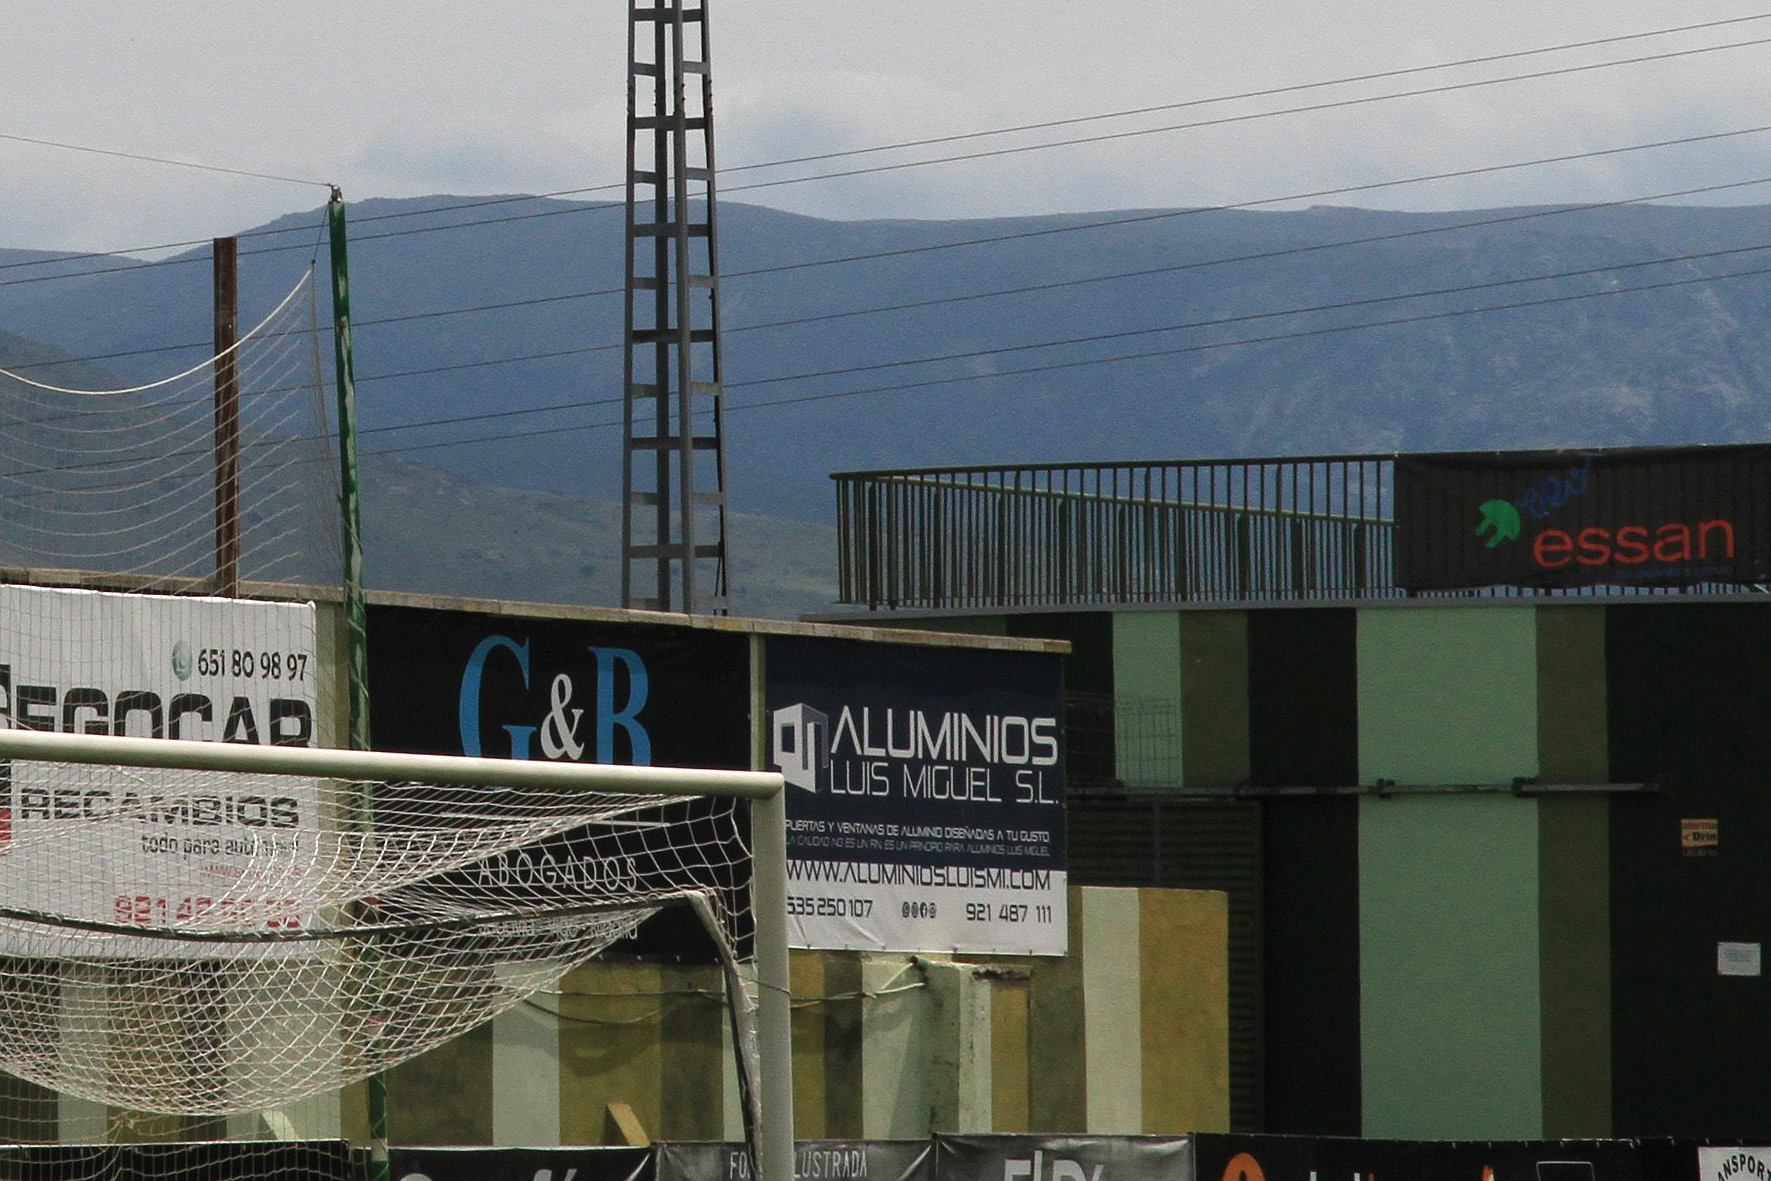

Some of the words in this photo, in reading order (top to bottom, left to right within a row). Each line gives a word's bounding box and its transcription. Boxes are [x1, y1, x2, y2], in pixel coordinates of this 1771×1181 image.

[1533, 519, 1736, 567] essan
[198, 649, 225, 677] 651
[232, 650, 255, 678] 80
[261, 652, 282, 680] 98
[287, 654, 309, 681] 97
[830, 705, 1059, 765] ALUMINIOS
[830, 759, 890, 797] LUIS
[903, 763, 1002, 803] MIGUEL
[1016, 770, 1059, 805] S.L.
[21, 788, 299, 828] RECAMBIOS
[827, 821, 835, 834] Y
[886, 824, 899, 836] DE
[140, 832, 178, 854] todo
[183, 837, 220, 861] para
[478, 852, 638, 893] ABOGADOS
[786, 860, 1052, 891] WWW.ALUMINIOSLUISMI.COM
[817, 898, 847, 918] 250
[849, 899, 874, 919] 107
[966, 903, 991, 922] 921
[999, 904, 1028, 923] 487
[1036, 905, 1053, 924] 111
[793, 1151, 868, 1181] LUSTRADA
